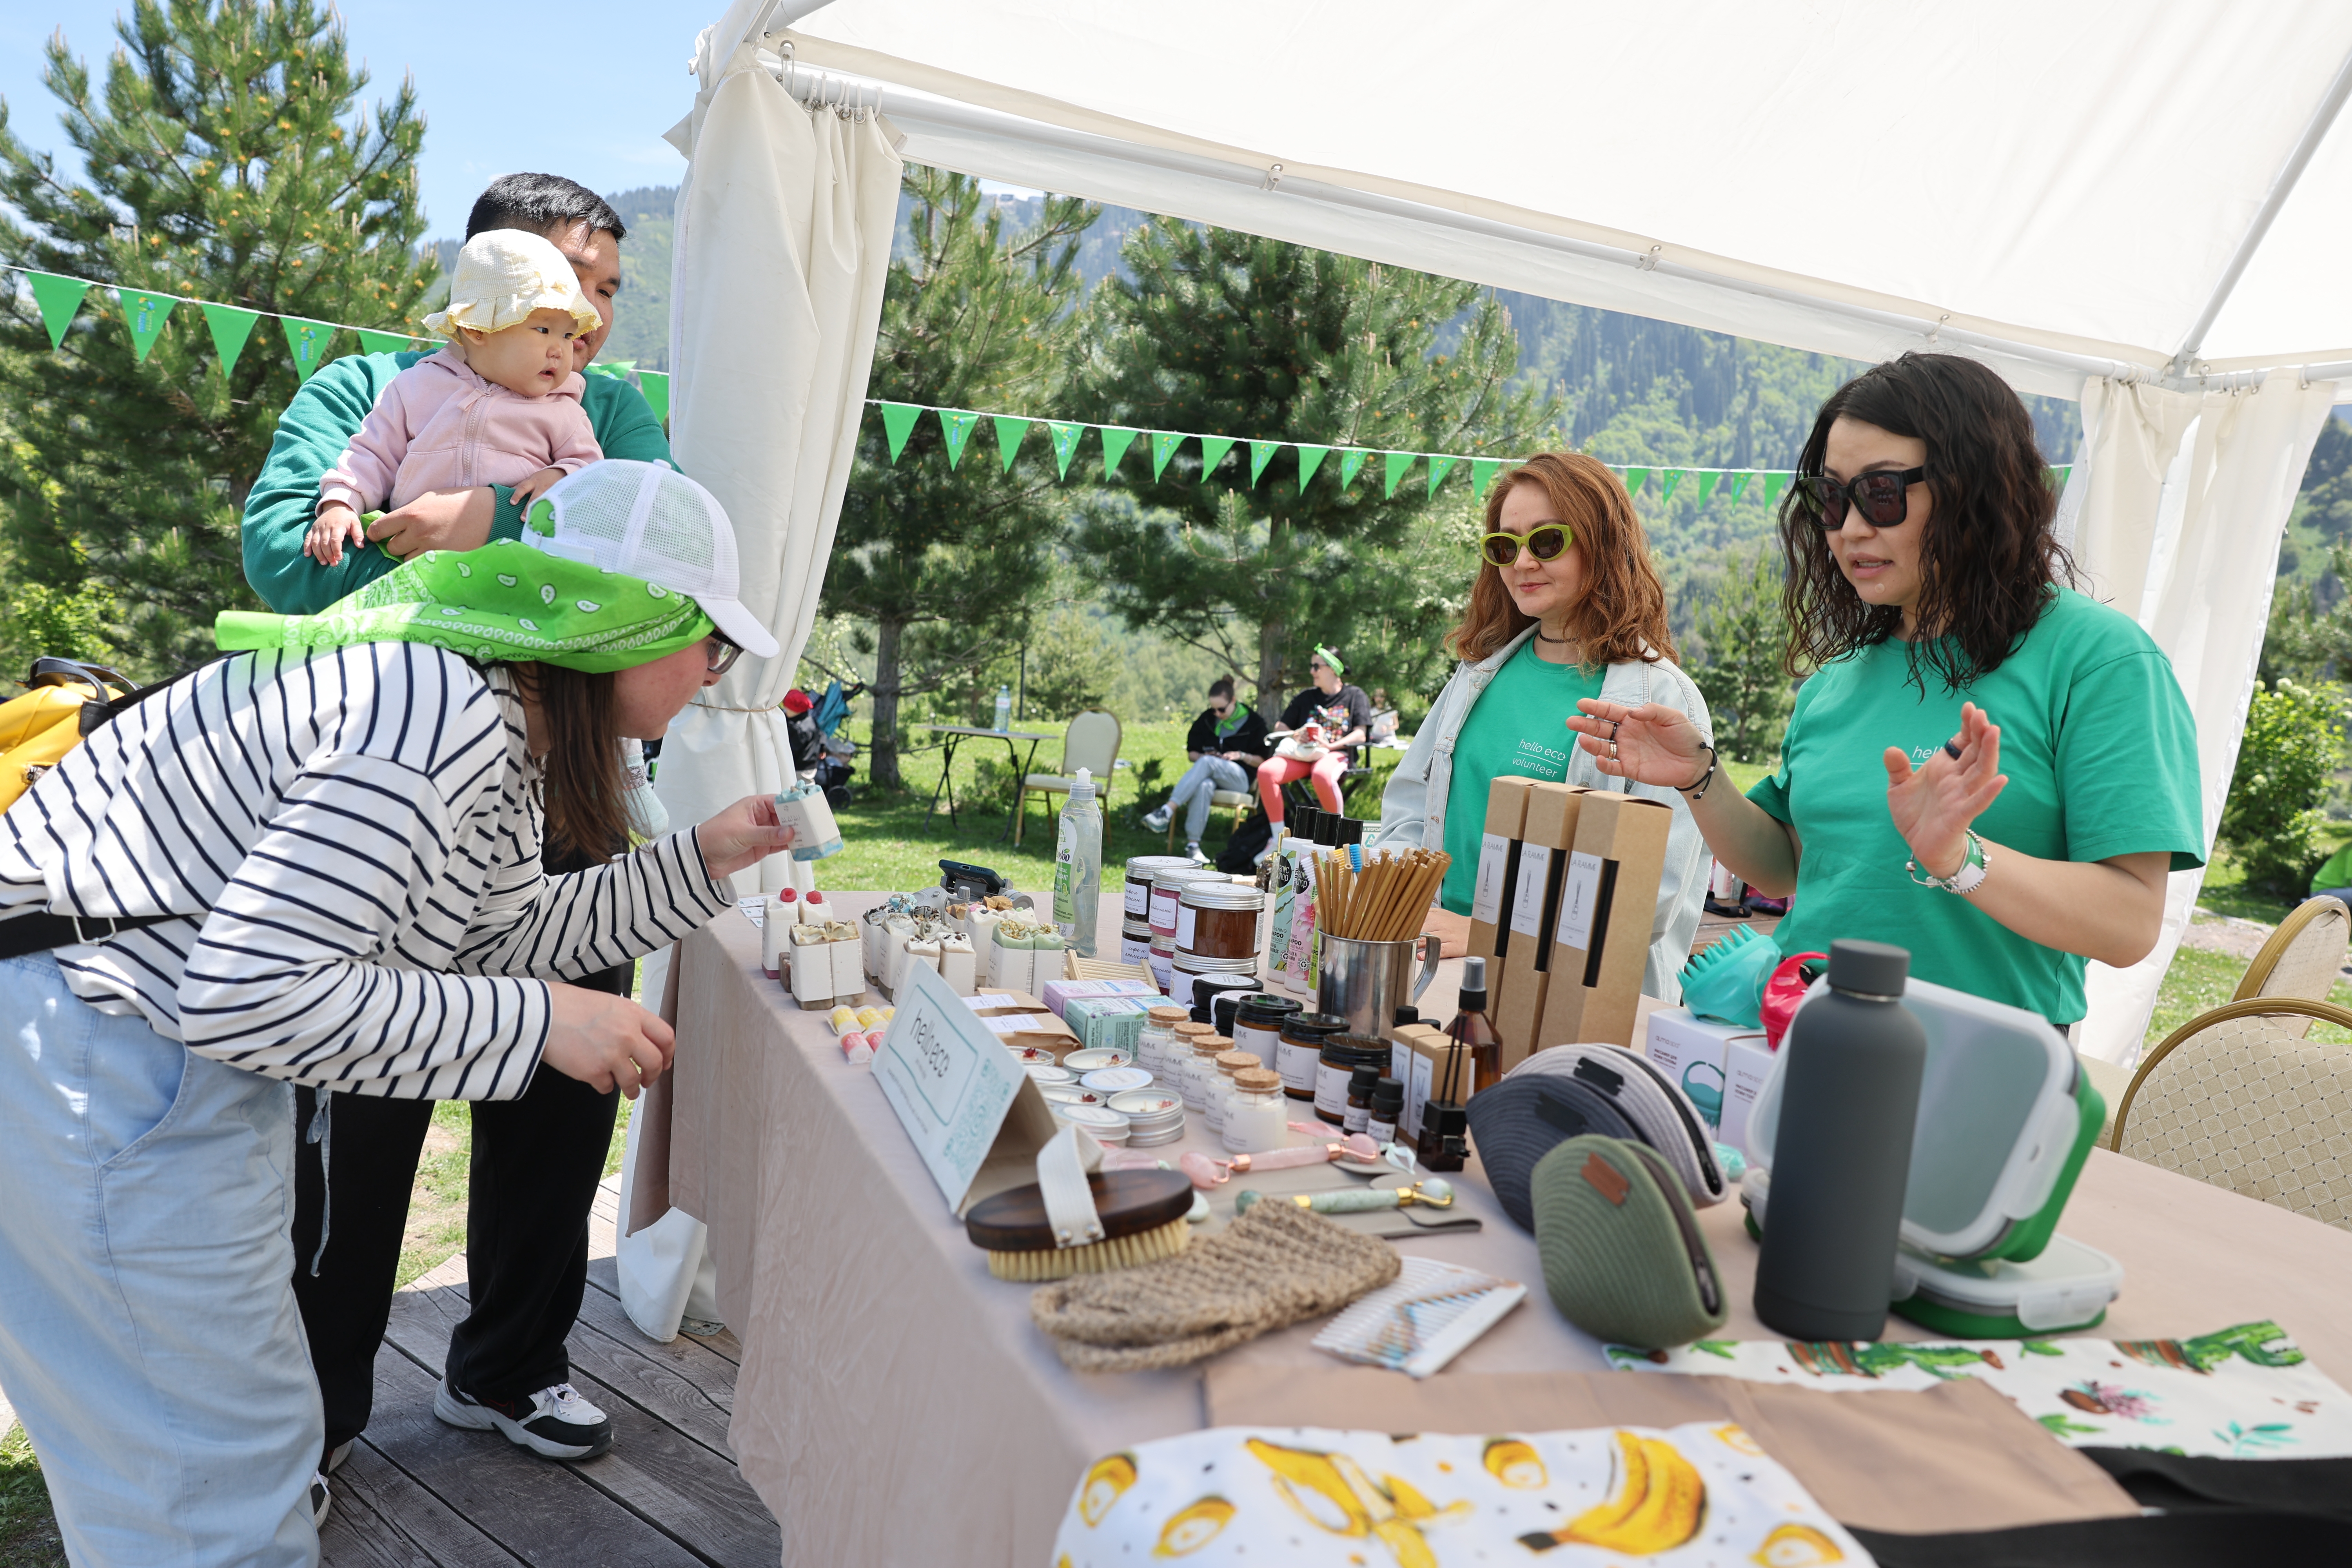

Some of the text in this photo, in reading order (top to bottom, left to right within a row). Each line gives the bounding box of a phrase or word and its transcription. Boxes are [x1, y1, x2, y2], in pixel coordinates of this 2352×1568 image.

[1518, 739, 1543, 753] hello
[1912, 746, 1943, 759] hel
[1512, 758, 1558, 777] volunteer
[1278, 872, 1289, 882] shop
[1297, 878, 1307, 889] shop
